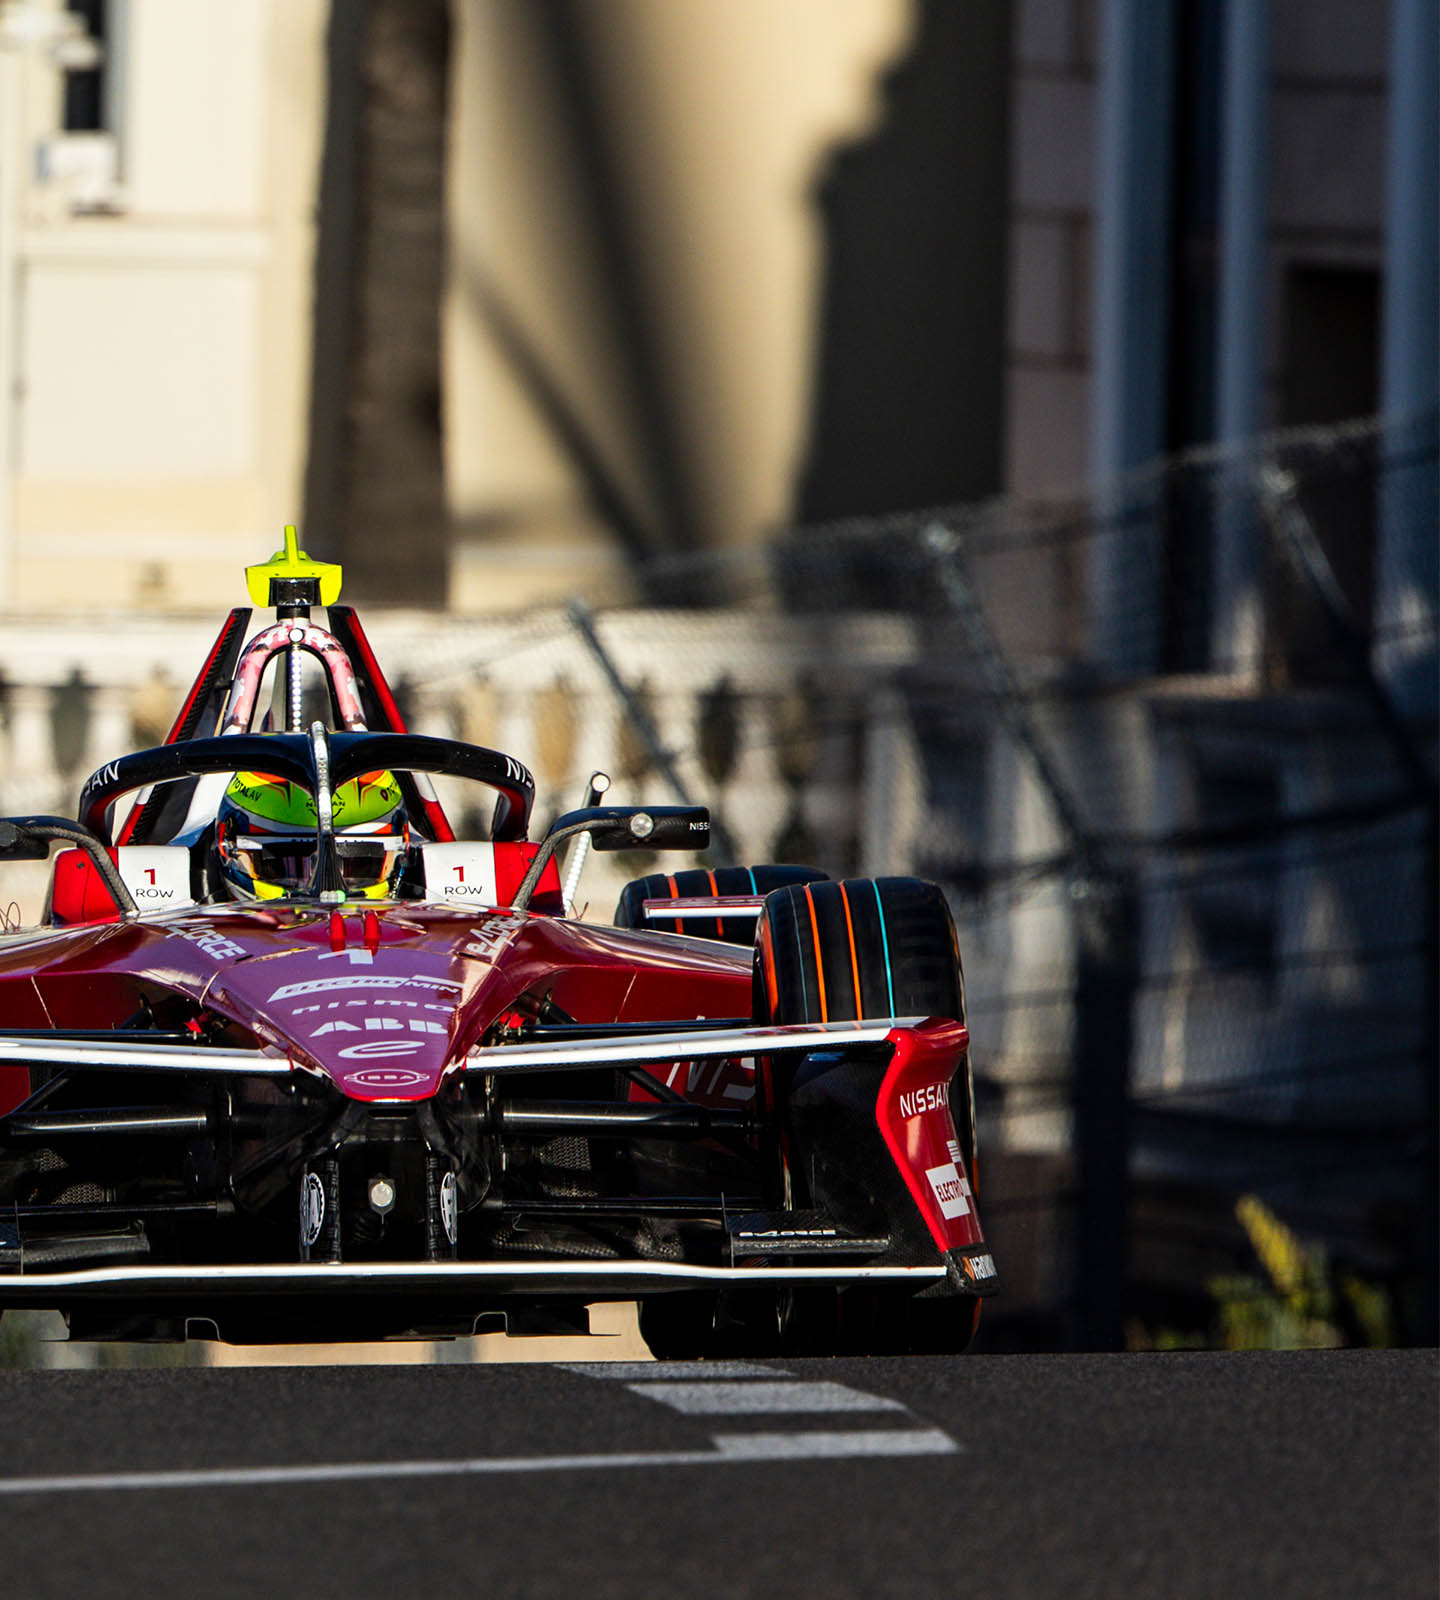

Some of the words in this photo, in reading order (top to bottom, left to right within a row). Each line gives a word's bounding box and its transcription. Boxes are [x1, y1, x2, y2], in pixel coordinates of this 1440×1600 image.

[144, 868, 156, 885] 1
[453, 865, 465, 882] 1
[135, 888, 174, 898] ROW
[444, 886, 483, 895] ROW
[309, 1017, 449, 1037] ABB
